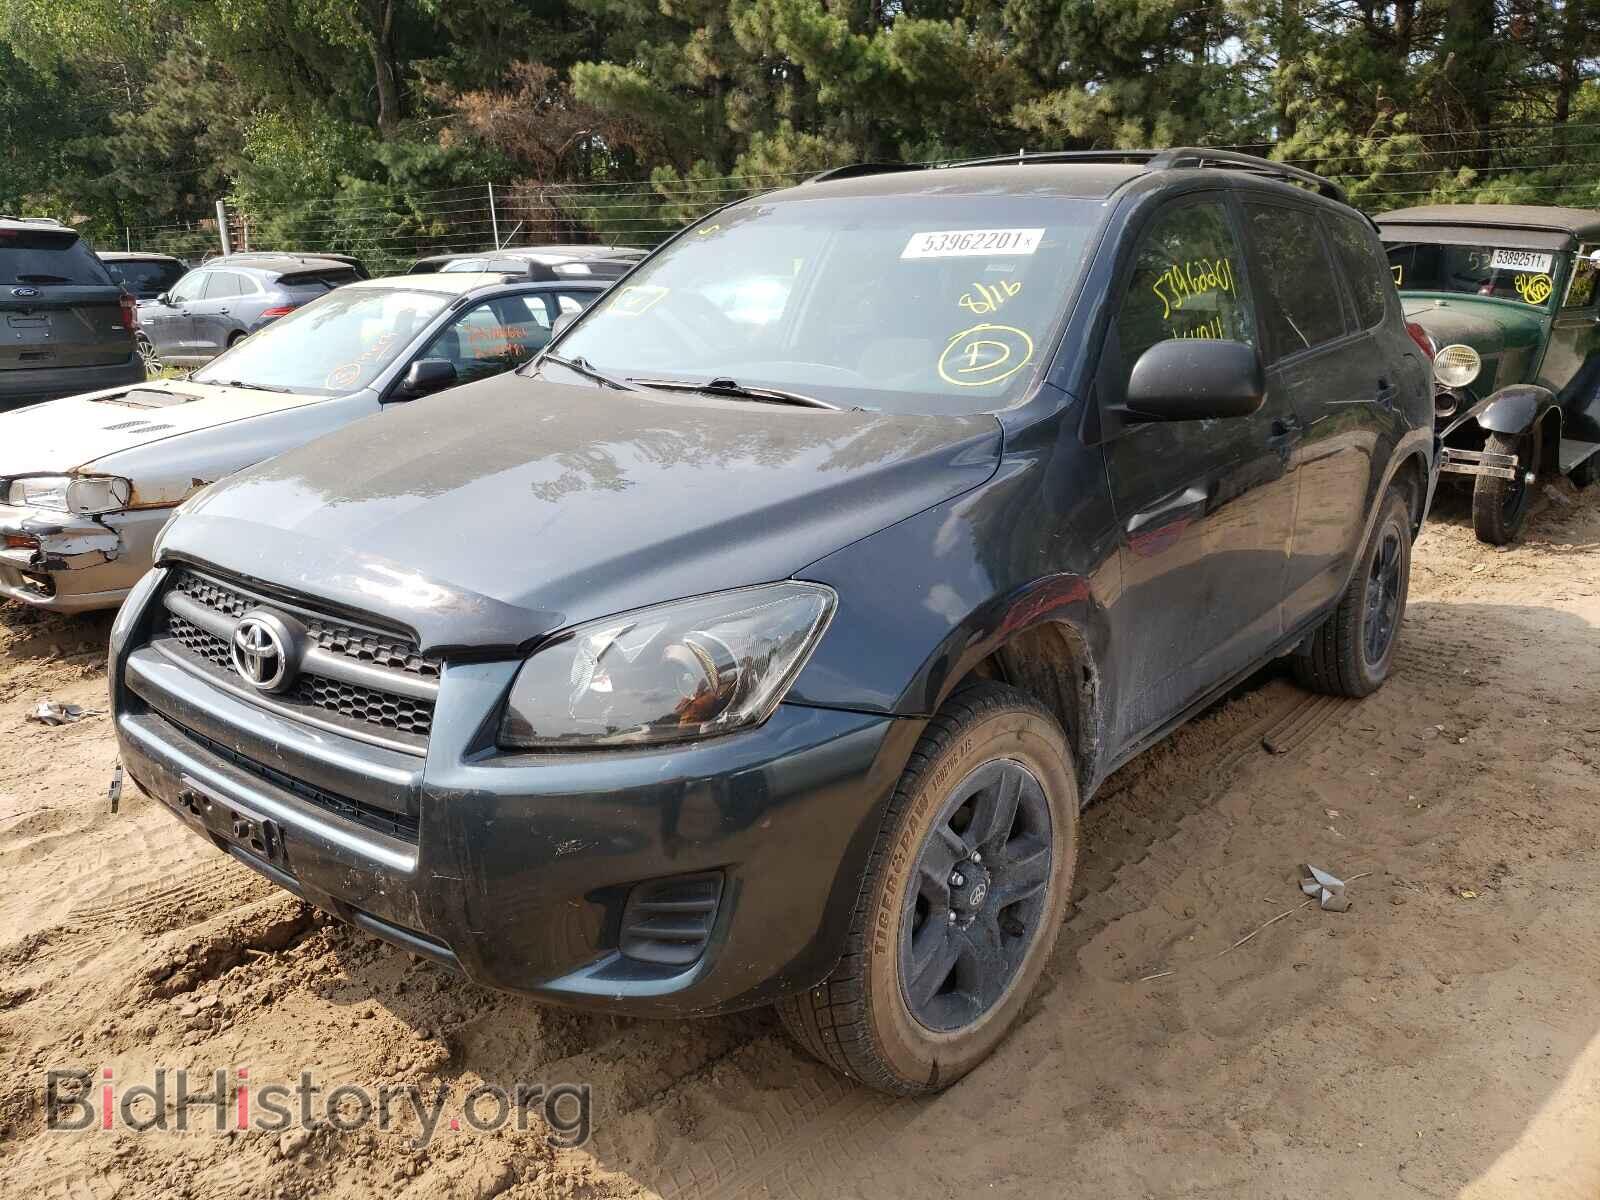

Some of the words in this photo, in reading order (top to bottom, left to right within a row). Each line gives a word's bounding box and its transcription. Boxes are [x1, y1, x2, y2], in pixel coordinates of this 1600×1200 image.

[921, 231, 1022, 253] 53962201
[1495, 250, 1541, 268] 53892511
[874, 873, 899, 955] TIGER
[900, 791, 929, 853] PAW
